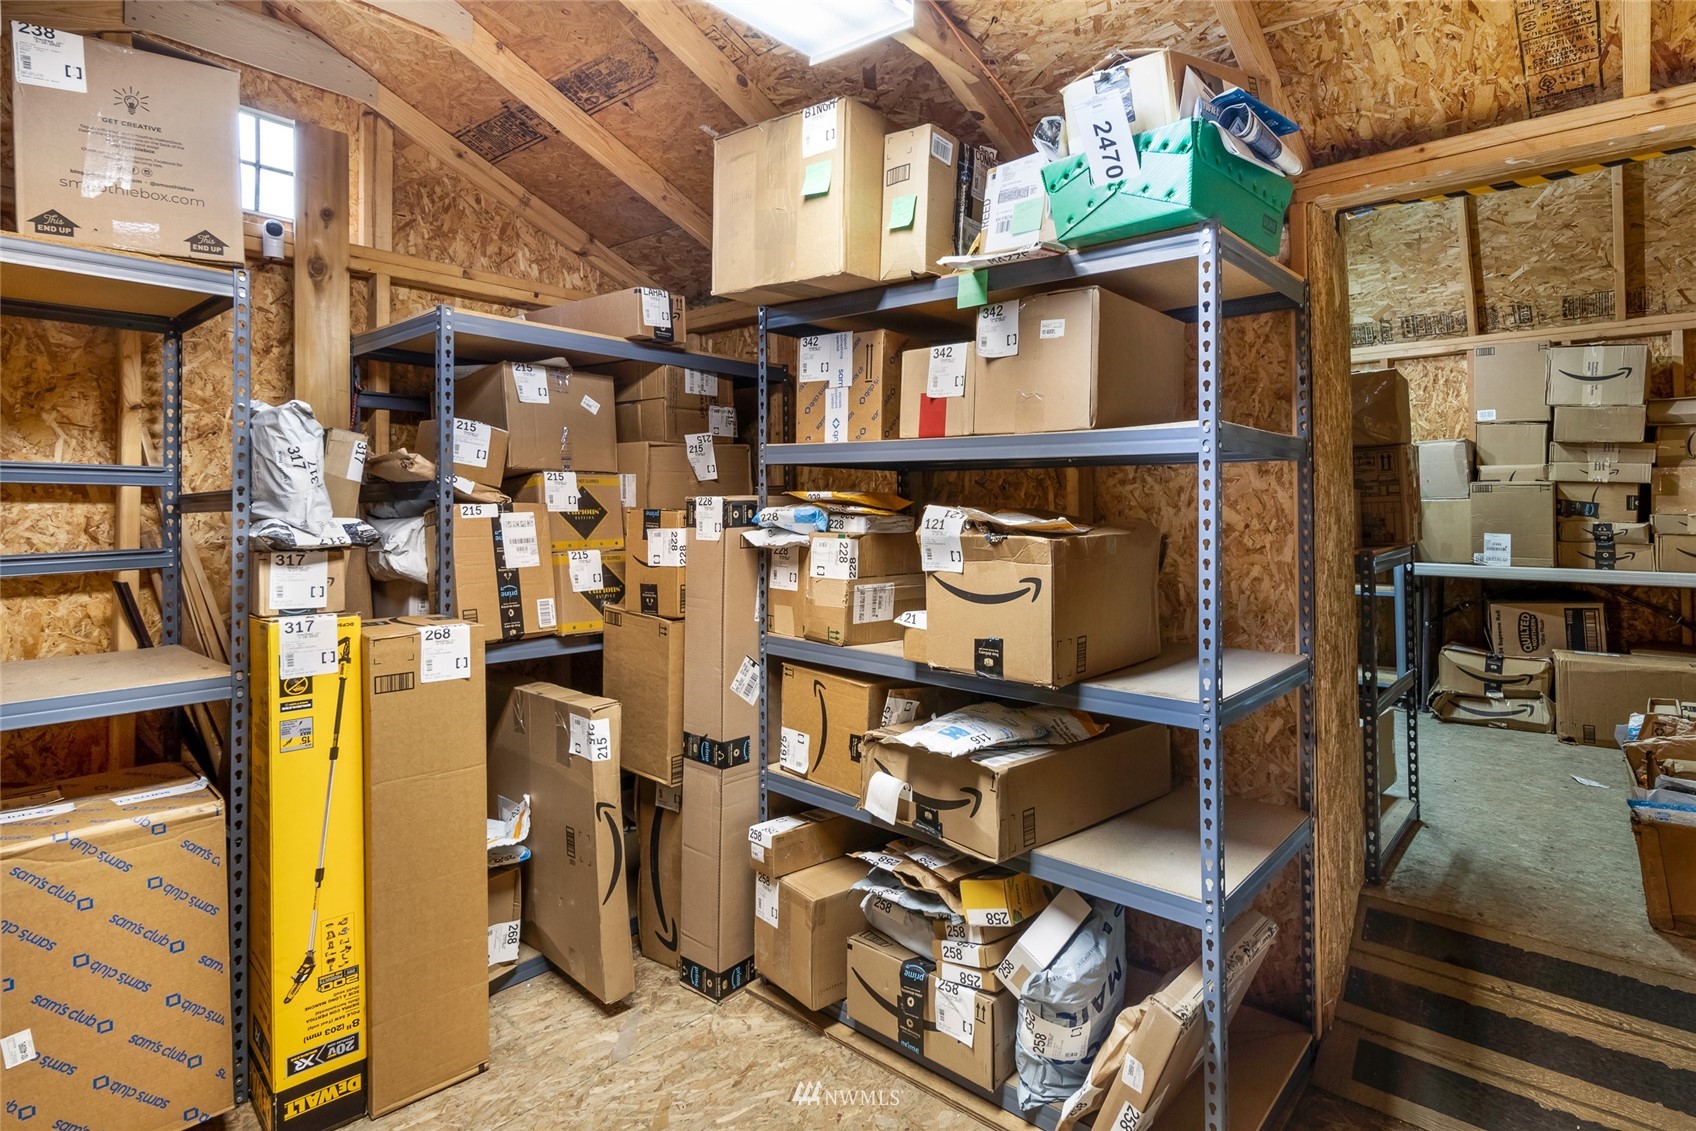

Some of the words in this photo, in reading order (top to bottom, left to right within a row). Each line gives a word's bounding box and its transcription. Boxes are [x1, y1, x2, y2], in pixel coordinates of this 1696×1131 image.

[18, 22, 55, 39] 238
[102, 117, 118, 125] GET
[121, 120, 162, 133] CREATIVE
[1093, 121, 1124, 179] 2470
[44, 214, 64, 225] This
[981, 199, 991, 228] REED
[37, 224, 57, 233] END
[58, 226, 72, 234] UP
[197, 234, 215, 245] This
[192, 244, 210, 252] END
[982, 305, 1003, 319] 342
[802, 336, 819, 347] 342
[933, 347, 953, 359] 342
[514, 362, 533, 373] 215
[456, 421, 476, 432] 215
[697, 435, 711, 444] 215
[287, 446, 306, 469] 317
[356, 442, 368, 464] 317
[689, 445, 704, 454] 215
[307, 461, 319, 485] 317
[547, 472, 564, 481] 215
[698, 496, 712, 506] 228
[462, 505, 482, 516] 215
[761, 512, 779, 522] 228
[829, 519, 845, 530] 228
[924, 518, 945, 530] 121
[275, 555, 305, 566] 317
[571, 552, 588, 560] 215
[679, 545, 687, 565] 228
[839, 542, 849, 564] 228
[849, 557, 857, 578] 228
[501, 589, 518, 598] prime
[284, 620, 314, 634] 317
[425, 628, 450, 640] 268
[1520, 613, 1533, 652] QUILTED
[970, 733, 992, 744] 116
[597, 738, 608, 759] 215
[750, 828, 762, 841] 258
[69, 837, 98, 855] club
[180, 840, 213, 861] sam's
[97, 850, 133, 873] sam's
[878, 856, 900, 866] 258
[10, 867, 50, 891] sam's
[47, 884, 77, 904] club
[758, 872, 770, 886] 258
[163, 882, 189, 900] club
[189, 896, 220, 916] sam's
[873, 897, 892, 913] 258
[986, 912, 1009, 925] 258
[109, 914, 145, 935] sam's
[143, 930, 169, 948] club
[507, 924, 519, 945] 268
[947, 925, 966, 938] 258
[18, 928, 57, 951] sam's
[942, 946, 962, 960] 258
[90, 959, 118, 978] club
[904, 969, 925, 981] prime
[998, 959, 1015, 979] 258
[117, 972, 152, 993] sam's
[938, 979, 959, 996] 258
[959, 972, 981, 988] 258
[305, 1001, 327, 1012] MANCHE
[329, 995, 343, 1003] LONG
[342, 1002, 360, 1011] SIERRA
[31, 994, 69, 1016] sam's
[68, 1009, 97, 1028] club
[180, 999, 207, 1016] club
[303, 1031, 322, 1044] mm)
[324, 1023, 345, 1036] (203
[128, 1034, 163, 1054] sam's
[161, 1045, 188, 1064] club
[1033, 1032, 1047, 1054] 258
[39, 1055, 77, 1076] sam's
[293, 1053, 315, 1072] XR
[109, 1081, 138, 1099] club
[136, 1091, 170, 1110] sam's
[1120, 1105, 1141, 1131] 258
